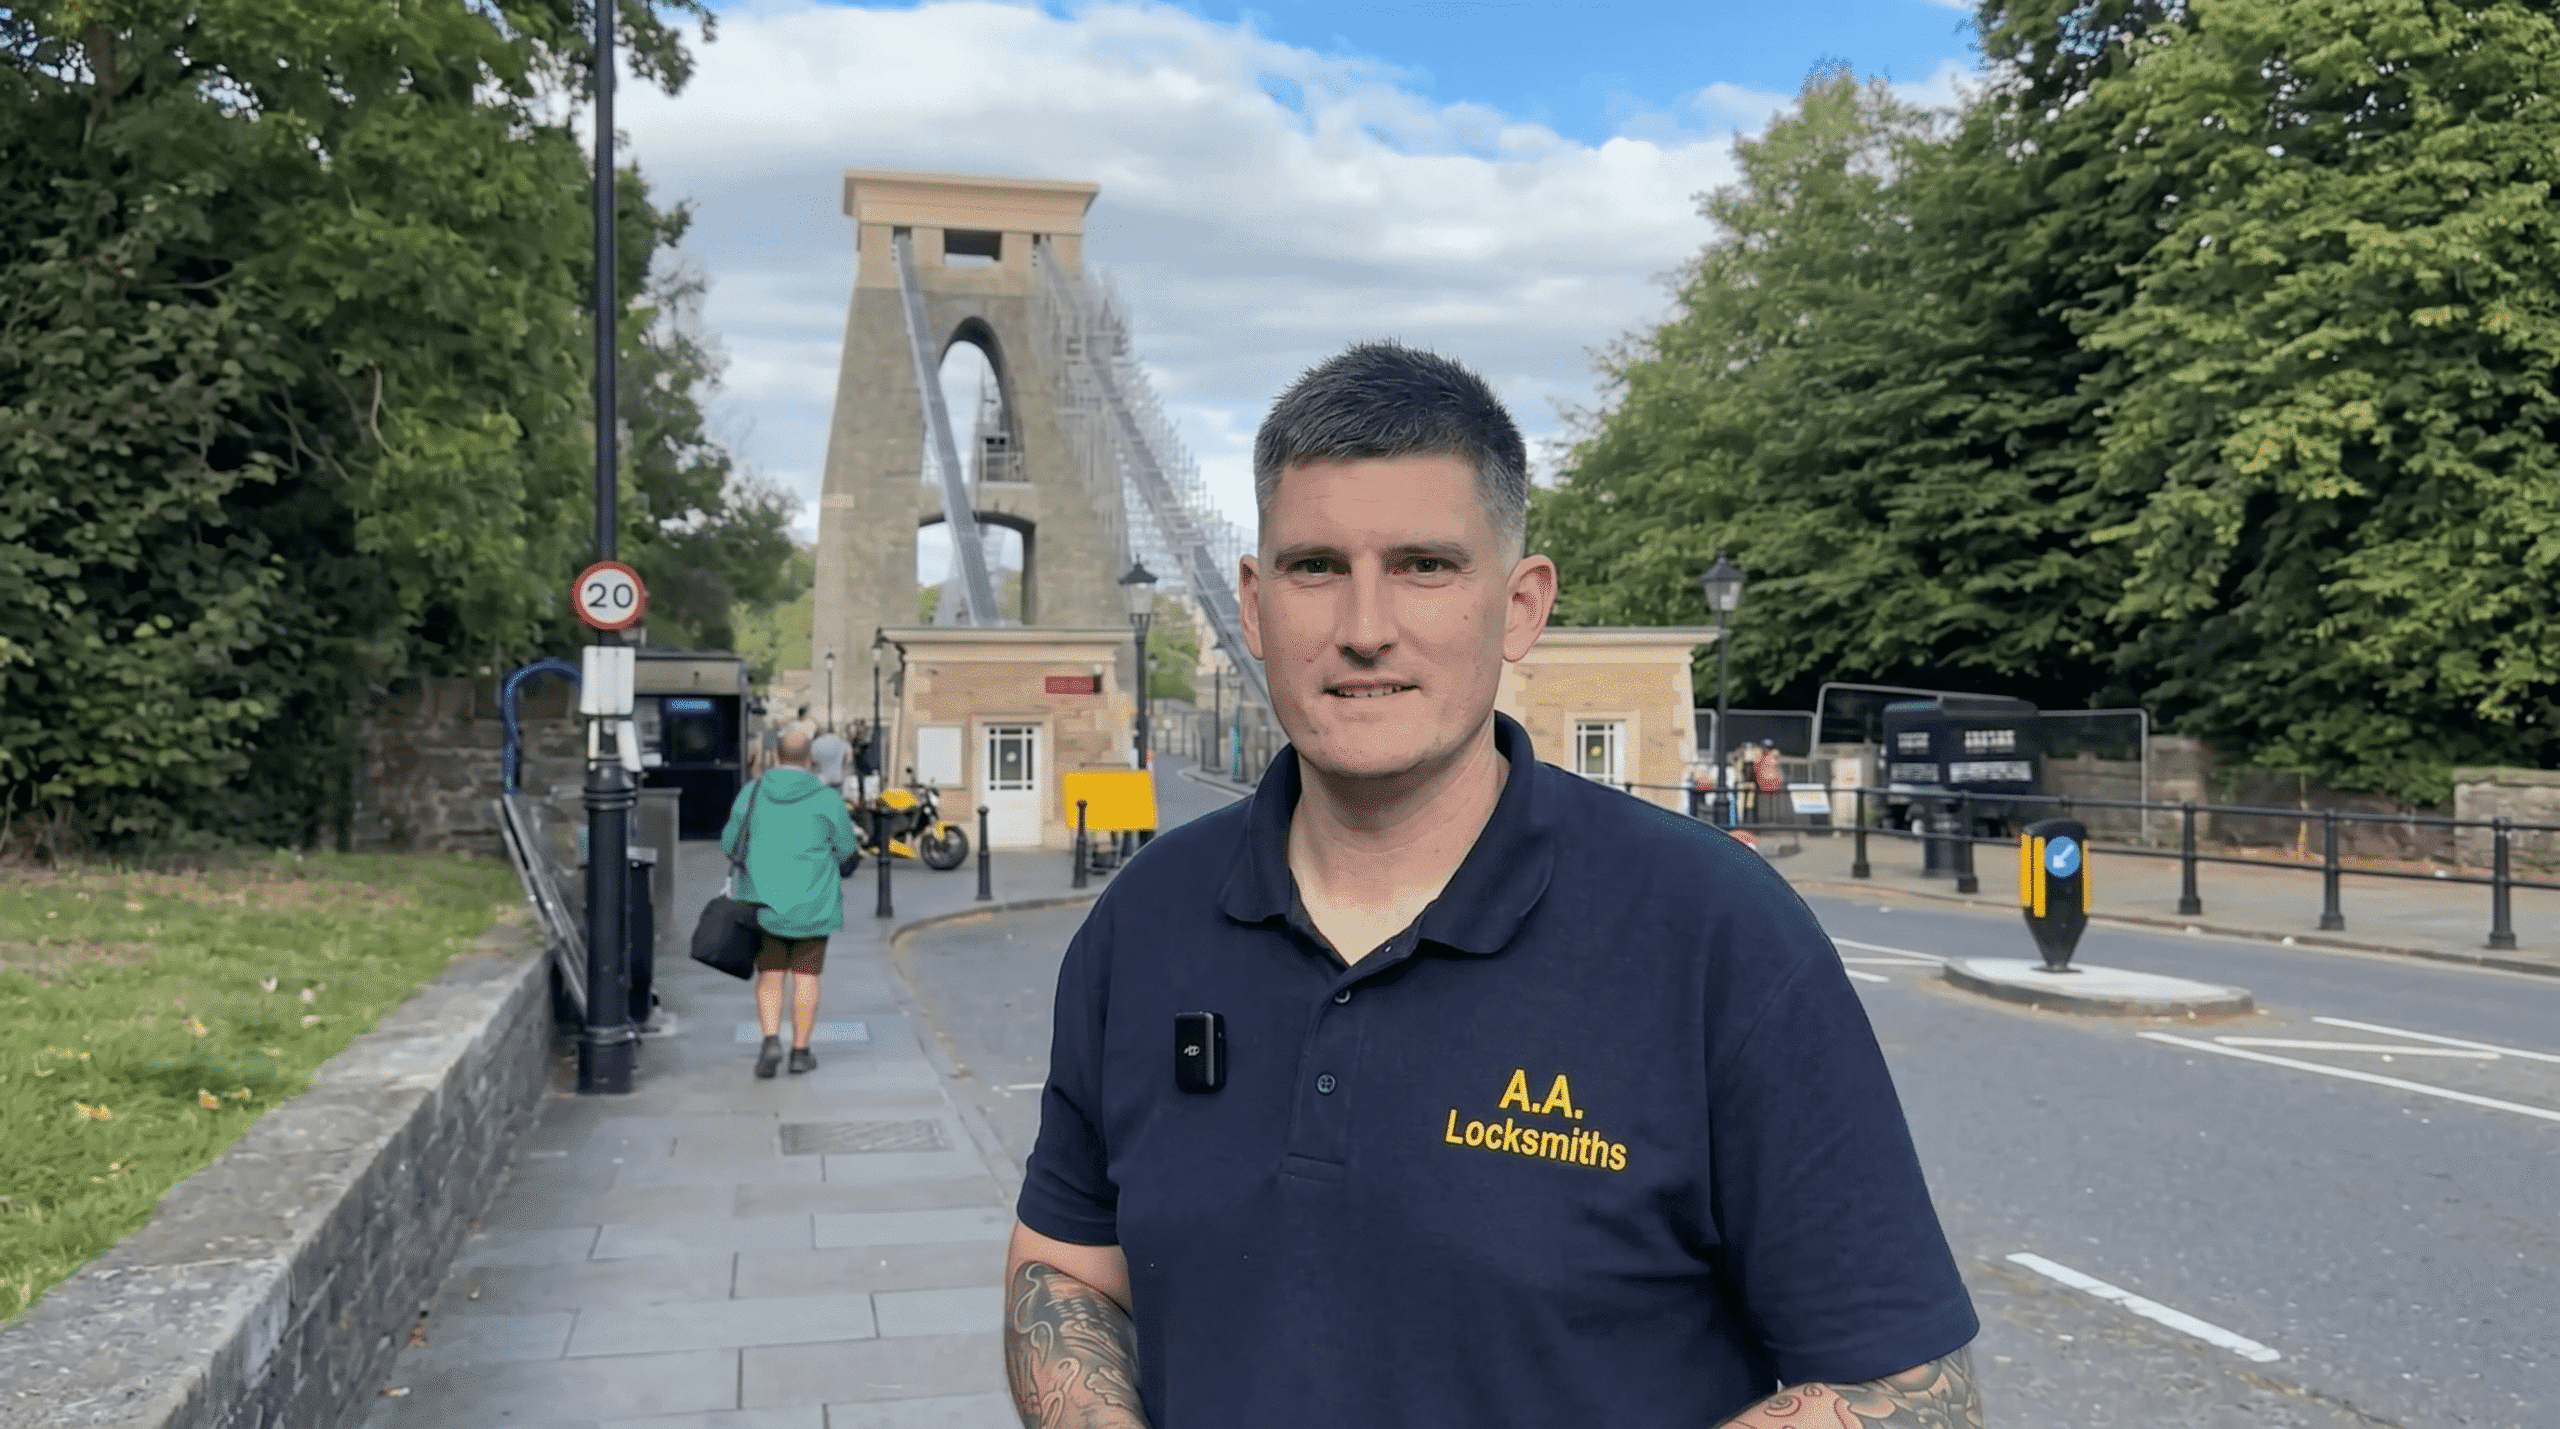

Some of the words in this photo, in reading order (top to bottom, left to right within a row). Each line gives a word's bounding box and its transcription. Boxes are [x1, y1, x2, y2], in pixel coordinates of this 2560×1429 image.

[588, 582, 633, 608] 20
[1498, 1068, 1584, 1120] A.A.
[1445, 1109, 1627, 1171] Locksmiths
